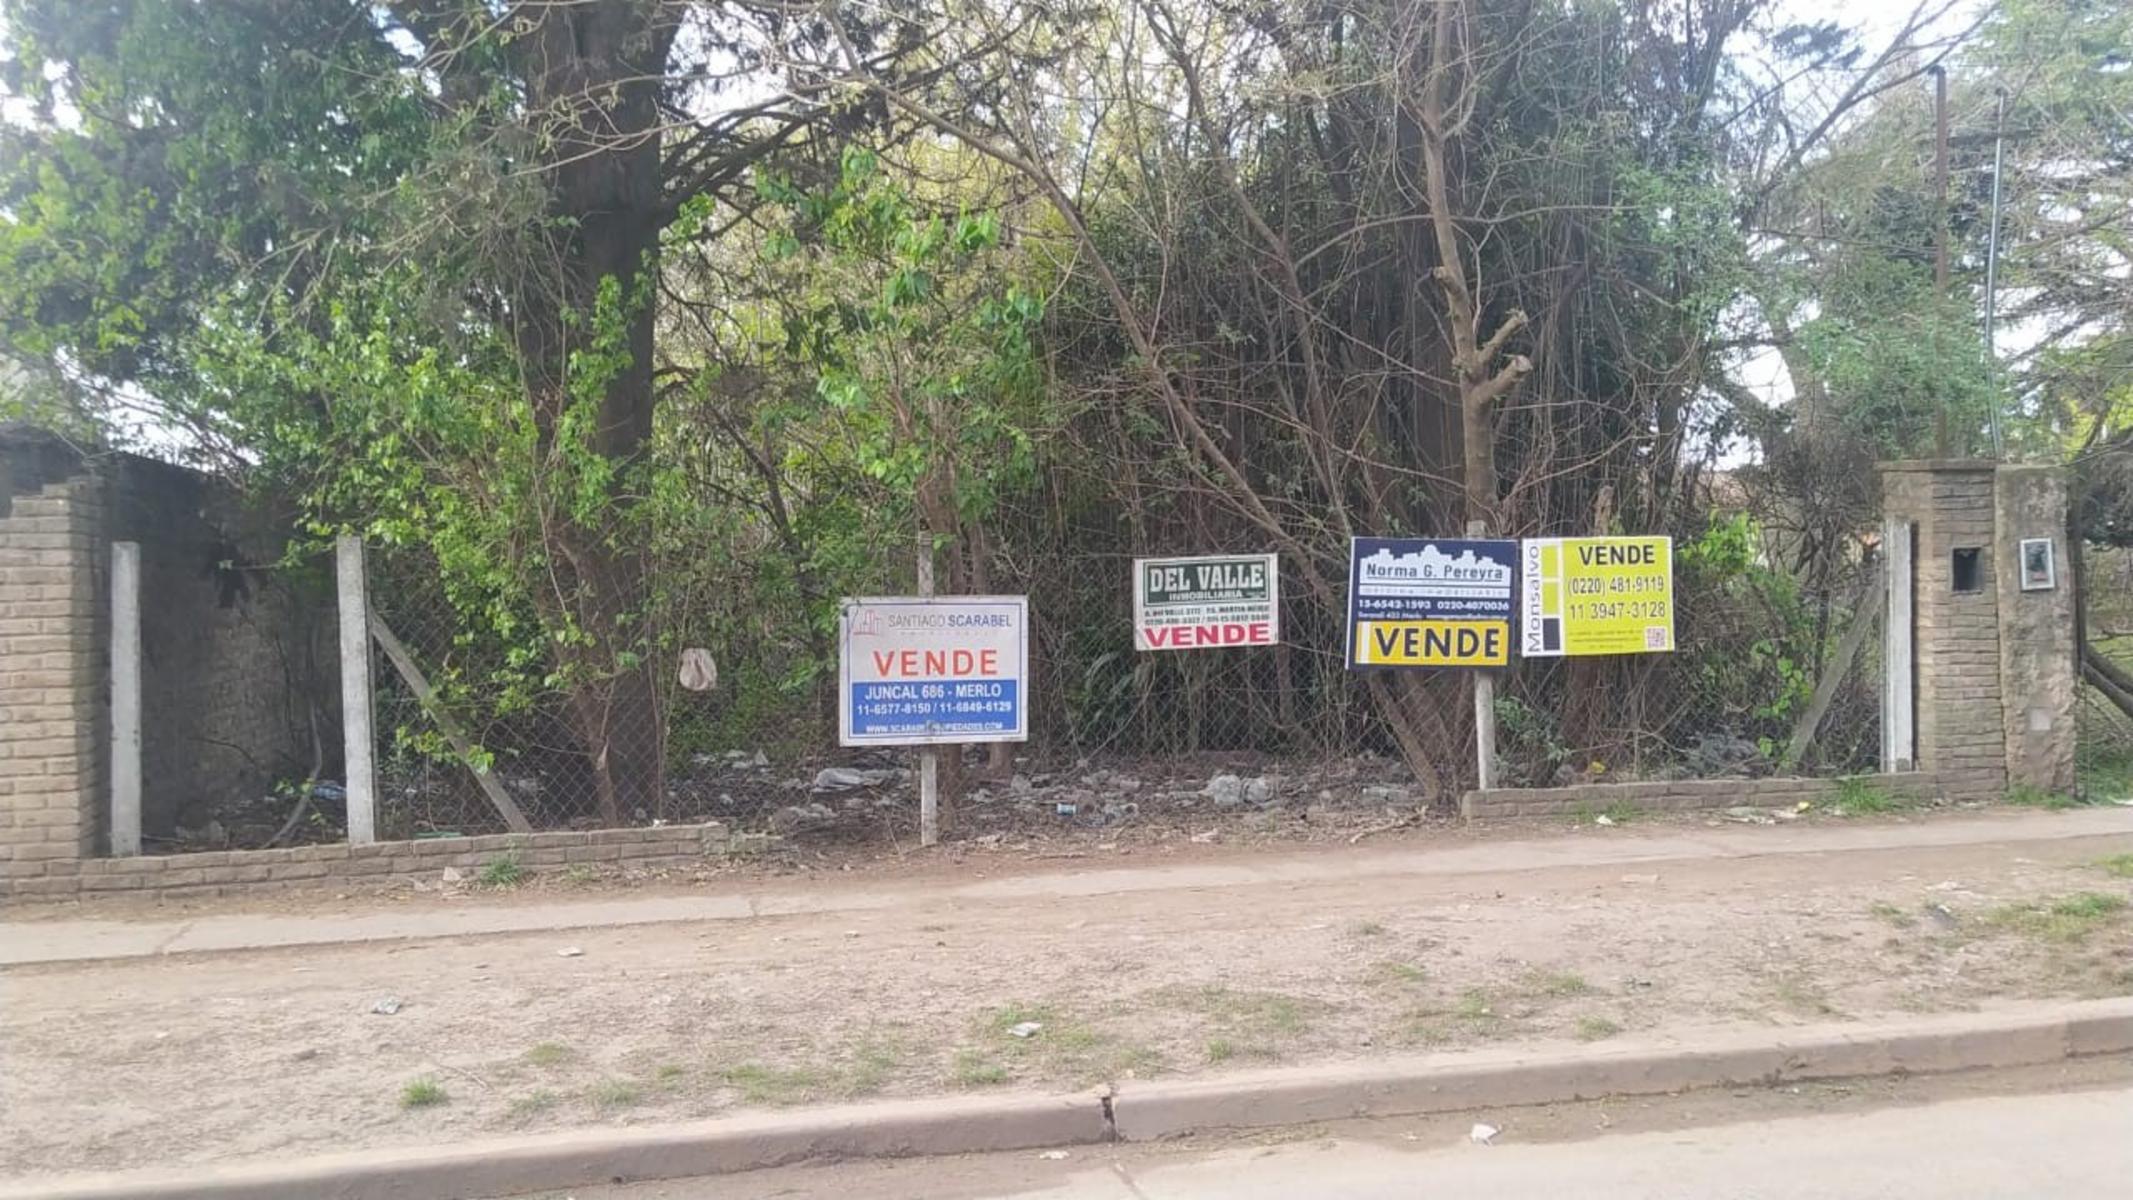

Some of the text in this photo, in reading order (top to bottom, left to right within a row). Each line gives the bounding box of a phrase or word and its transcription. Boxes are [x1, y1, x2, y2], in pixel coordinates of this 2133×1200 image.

[1579, 544, 1655, 565] VENDE
[1150, 564, 1264, 592] DEL VALLE
[1366, 563, 1503, 581] Norma G. Pereyra
[1169, 589, 1243, 601] INMOBILIARIA
[1568, 575, 1665, 597] (0220) 481-9119
[1526, 546, 1540, 652] Monsalvo
[888, 614, 1012, 628] SANTIAGO SCARABEL
[1570, 601, 1666, 620] 11 3947-3128
[1144, 623, 1270, 648] VENDE
[1374, 628, 1499, 657] VENDE
[873, 649, 998, 677] VENDE
[864, 685, 918, 700] JUNCAL
[921, 684, 944, 699] 686
[955, 683, 1001, 698] MERLO
[857, 702, 931, 716] 11-6577-8150
[940, 701, 1012, 715] 11-6849-6129
